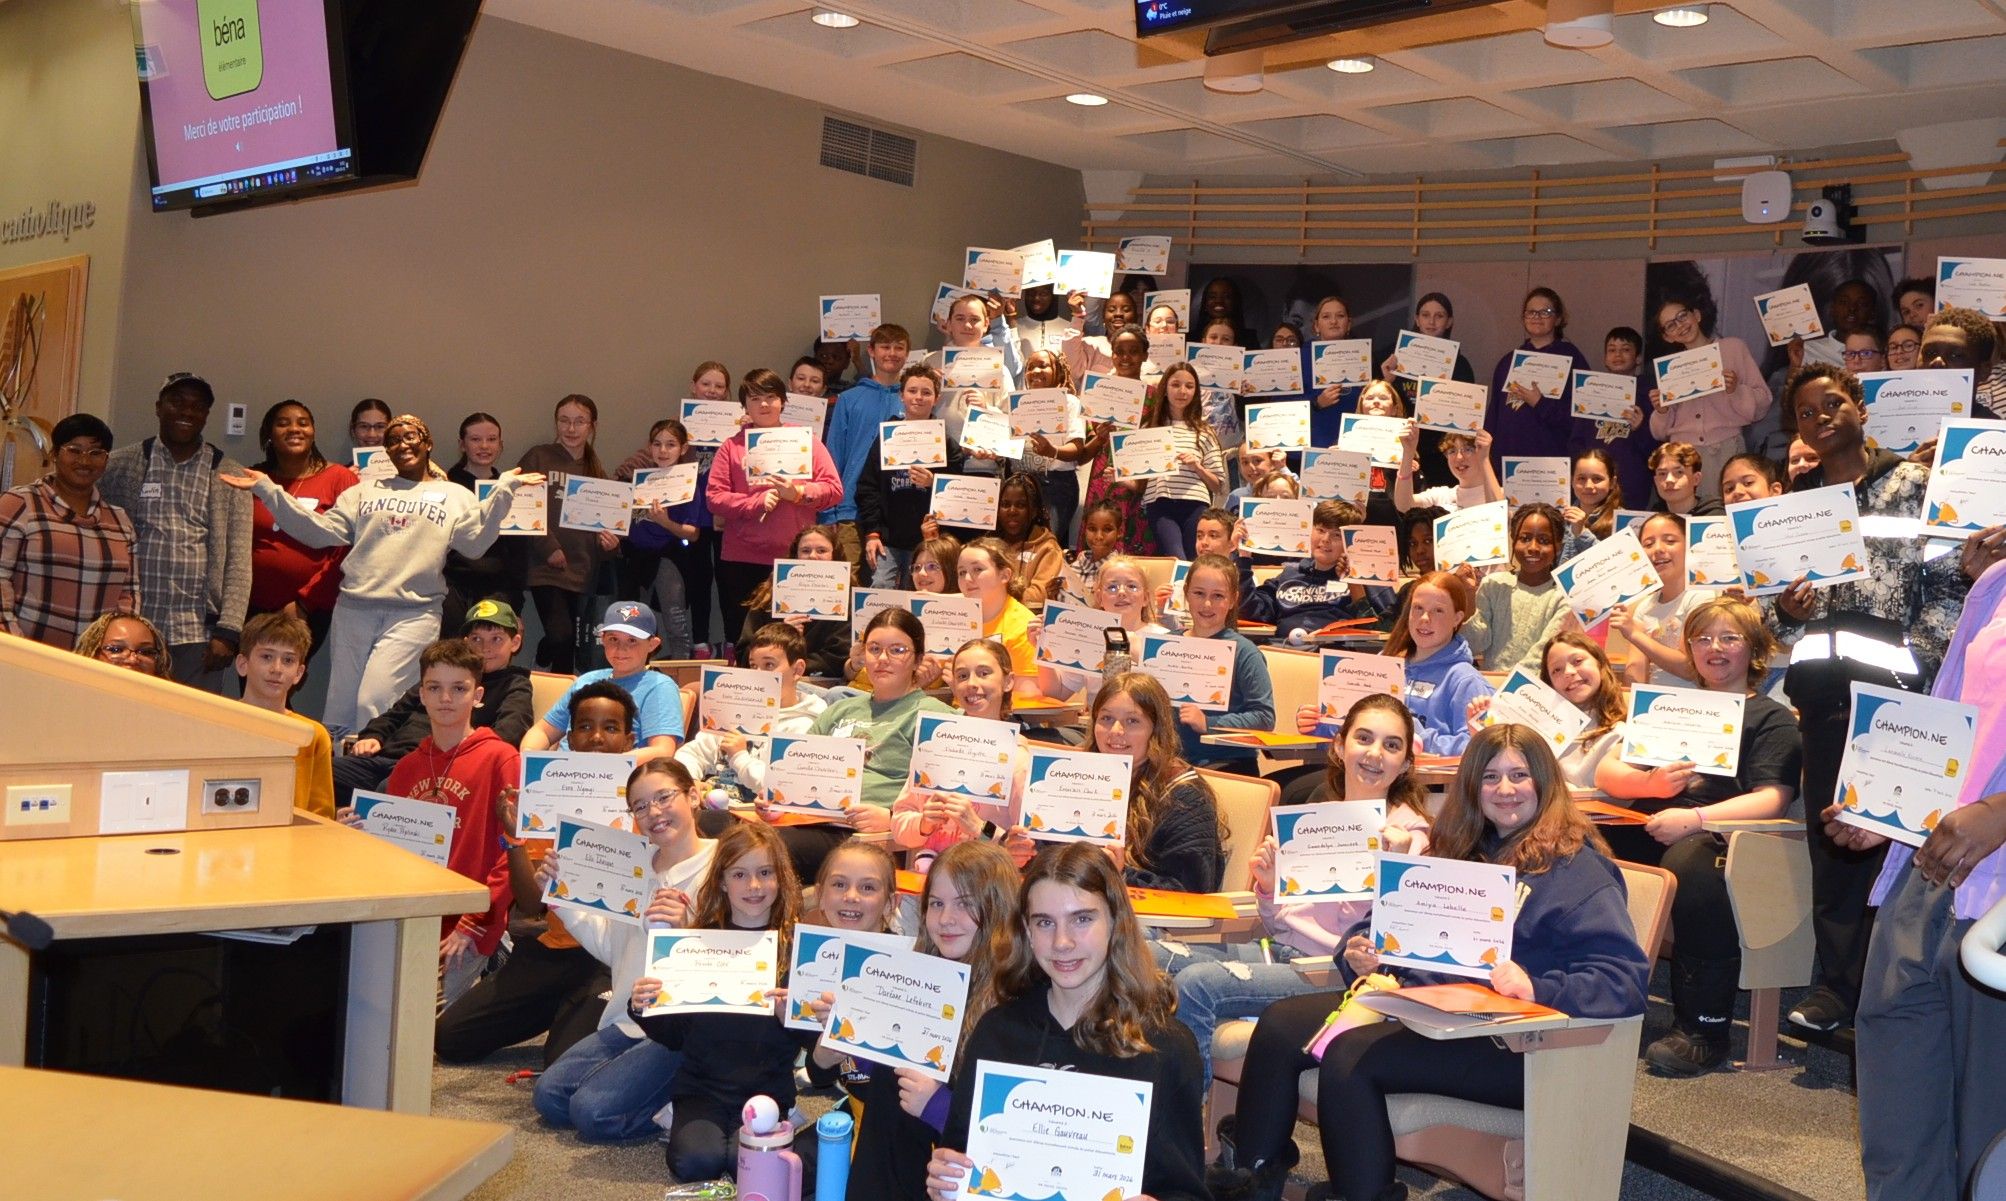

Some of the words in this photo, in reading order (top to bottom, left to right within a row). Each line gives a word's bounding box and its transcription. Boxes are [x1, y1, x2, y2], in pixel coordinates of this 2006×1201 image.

[1178, 8, 1191, 16] neige
[213, 16, 246, 47] béna
[218, 57, 247, 72] élémentaire
[183, 117, 207, 141] Merci
[207, 119, 218, 136] de
[218, 115, 241, 133] votre
[242, 100, 297, 131] participation
[0, 200, 96, 243] catholique
[1880, 389, 1950, 399] CHAMPION.NE
[358, 498, 448, 527] VANCOUVER
[1757, 509, 1833, 529] CHAMPION.NE
[1290, 585, 1327, 596] CANAD
[1160, 649, 1216, 661] CHAMPION.NE
[1337, 667, 1388, 679] CHAMPION.NE
[717, 682, 765, 692] CHAMPION.NE
[1519, 689, 1563, 725] CHAMPION.NE
[1654, 704, 1720, 718] CHAMPION.NE
[936, 731, 997, 746] CHAMPION.NE
[1875, 718, 1948, 746] CHAMPION.NE
[787, 750, 845, 762] CHAMPION.NE
[545, 770, 614, 780] CHAMPION.NE
[1049, 770, 1111, 782] CHAMPION.NE
[436, 777, 471, 801] YORK
[372, 811, 434, 828] CHAMPION.NE
[1297, 823, 1363, 835] CHAMPION.NE
[575, 838, 631, 859] CHAMPION.NE
[1404, 879, 1487, 898] CHAMPION.NE
[675, 947, 752, 956] CHAMPION.NE
[865, 966, 942, 993] CHAMPION.NE
[1012, 1098, 1114, 1123] CHAMPION.NE
[1032, 1123, 1050, 1136] Ellie
[1054, 1127, 1088, 1141] Gauvreau
